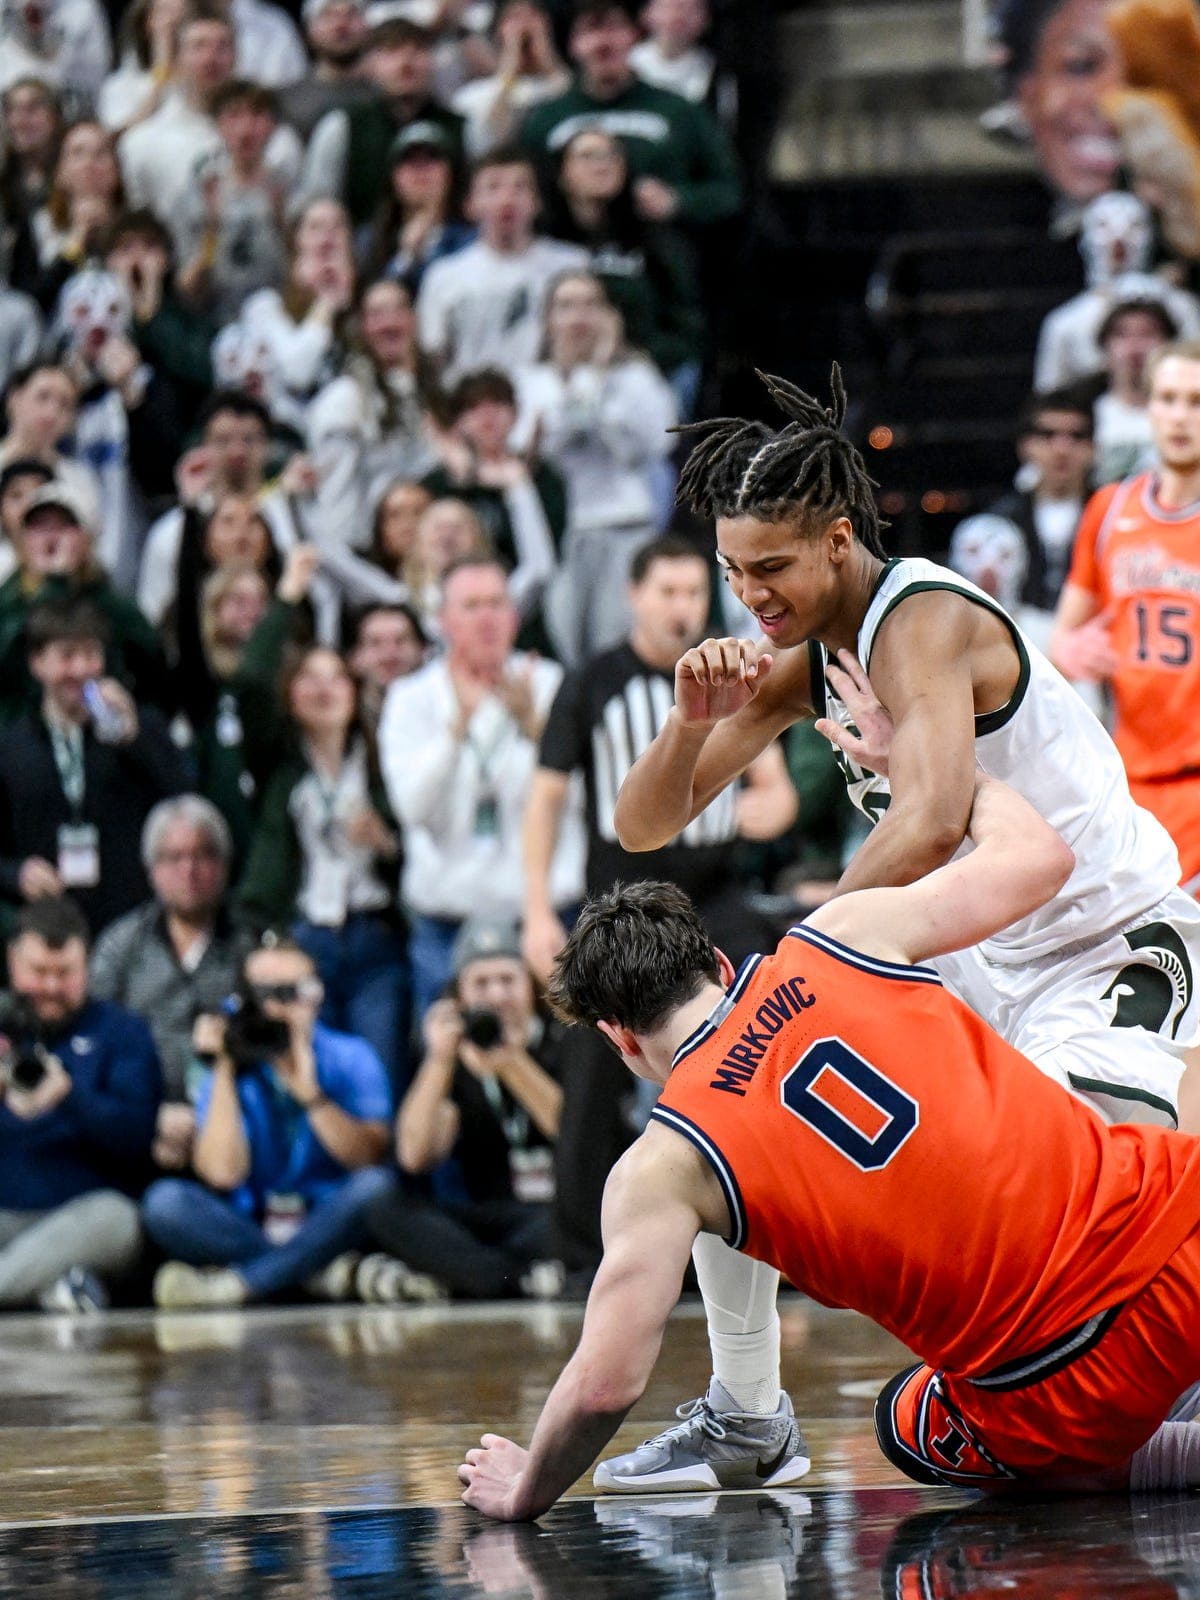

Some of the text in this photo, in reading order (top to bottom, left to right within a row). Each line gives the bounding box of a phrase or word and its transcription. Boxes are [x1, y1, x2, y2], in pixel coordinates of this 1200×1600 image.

[1135, 604, 1192, 666] 15
[709, 976, 817, 1097] MIRKOVIC
[780, 1035, 920, 1173] 0
